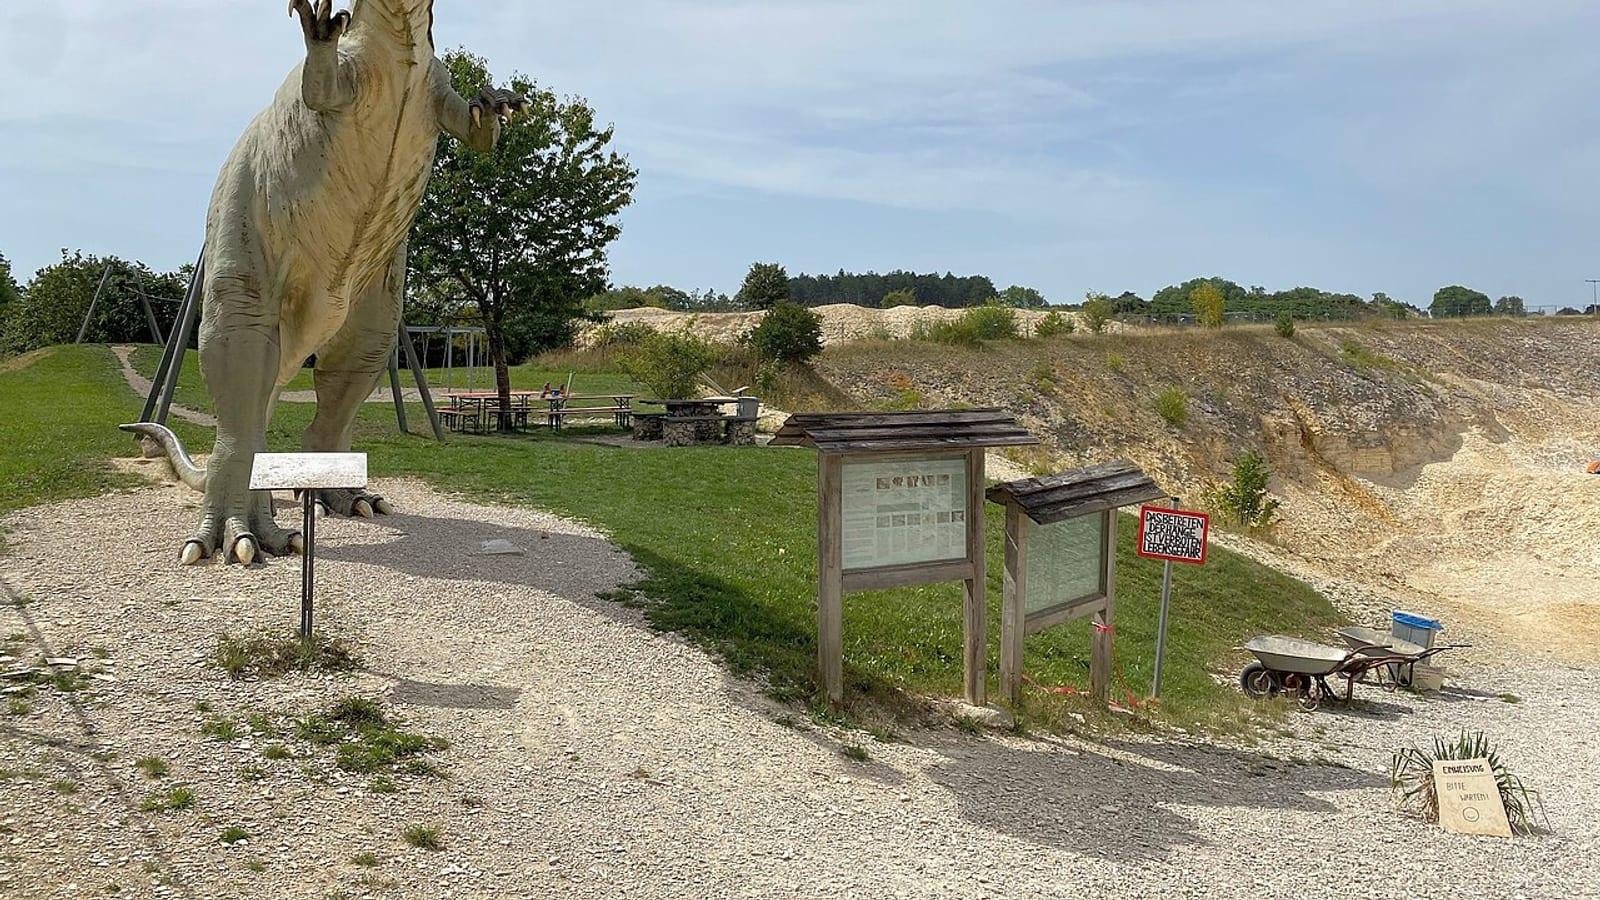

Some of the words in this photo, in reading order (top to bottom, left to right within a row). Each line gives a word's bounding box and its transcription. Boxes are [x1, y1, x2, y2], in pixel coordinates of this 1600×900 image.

[1146, 512, 1162, 523] DAS
[1162, 514, 1204, 528] BETRETEN
[1149, 523, 1166, 533] DER
[1144, 532, 1159, 543] IST
[1159, 532, 1203, 548] VERBOTEN
[1143, 542, 1201, 558] LEBENSGEFAHR
[1442, 765, 1484, 774] EINWEISUNG
[1446, 782, 1467, 791] BITTE
